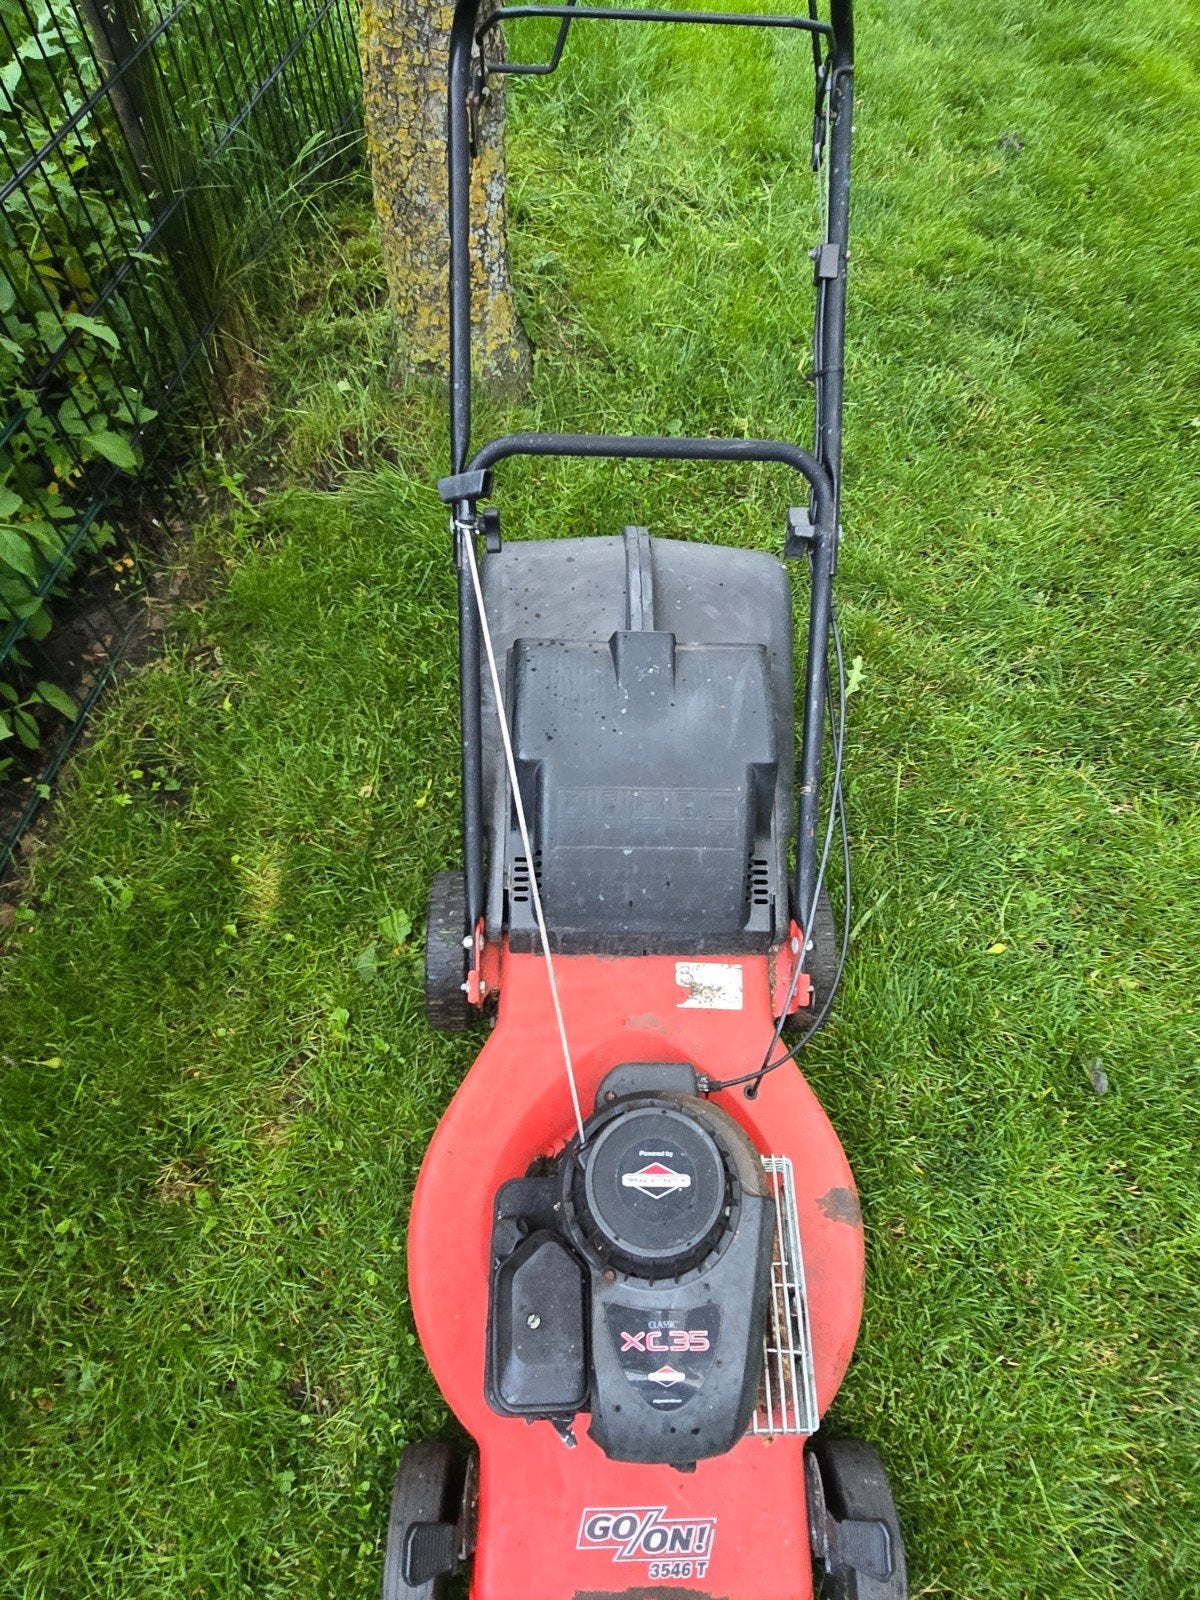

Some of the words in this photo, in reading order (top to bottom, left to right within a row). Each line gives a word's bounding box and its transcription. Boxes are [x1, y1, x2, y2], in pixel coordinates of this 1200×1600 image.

[648, 1321, 677, 1329] CLASSIC
[620, 1330, 710, 1352] XC35
[649, 1561, 691, 1579] 3546
[697, 1561, 708, 1578] T
